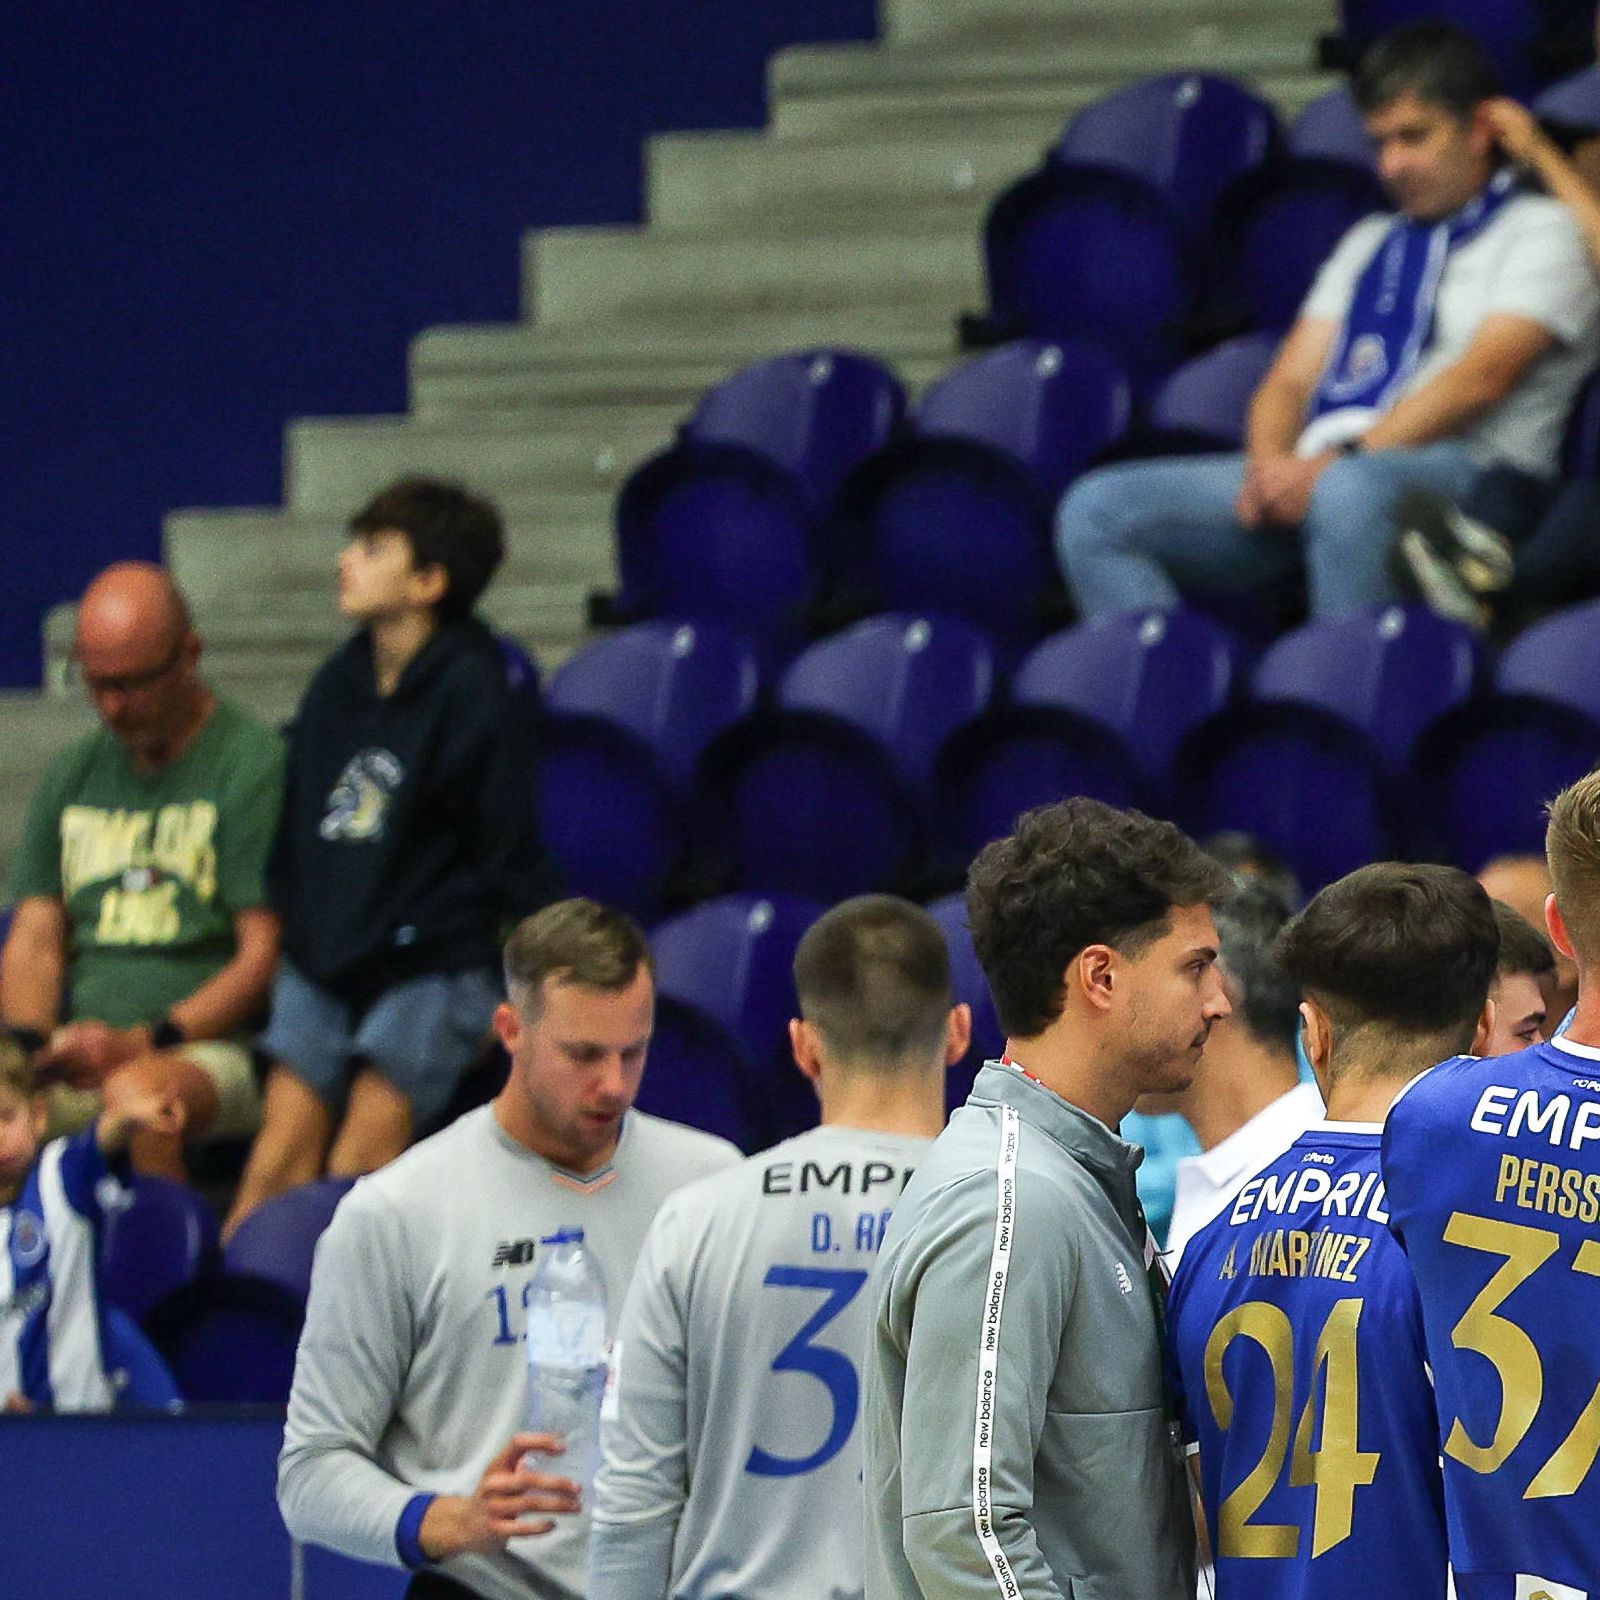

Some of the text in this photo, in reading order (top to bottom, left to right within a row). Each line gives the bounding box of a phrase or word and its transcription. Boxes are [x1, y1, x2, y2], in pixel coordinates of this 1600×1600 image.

[763, 1160, 914, 1195] EMP
[1229, 1167, 1391, 1225] EMPRIL
[811, 1212, 840, 1254] D.
[1000, 1178, 1013, 1251] new balance
[1249, 1225, 1372, 1283] MARTÍNEZ
[986, 1270, 1005, 1352] new balance
[744, 1263, 870, 1477] 3
[979, 1370, 993, 1448] new balance
[1205, 1298, 1380, 1560] 24
[977, 1467, 988, 1517] balance
[994, 1554, 1017, 1599] balance
